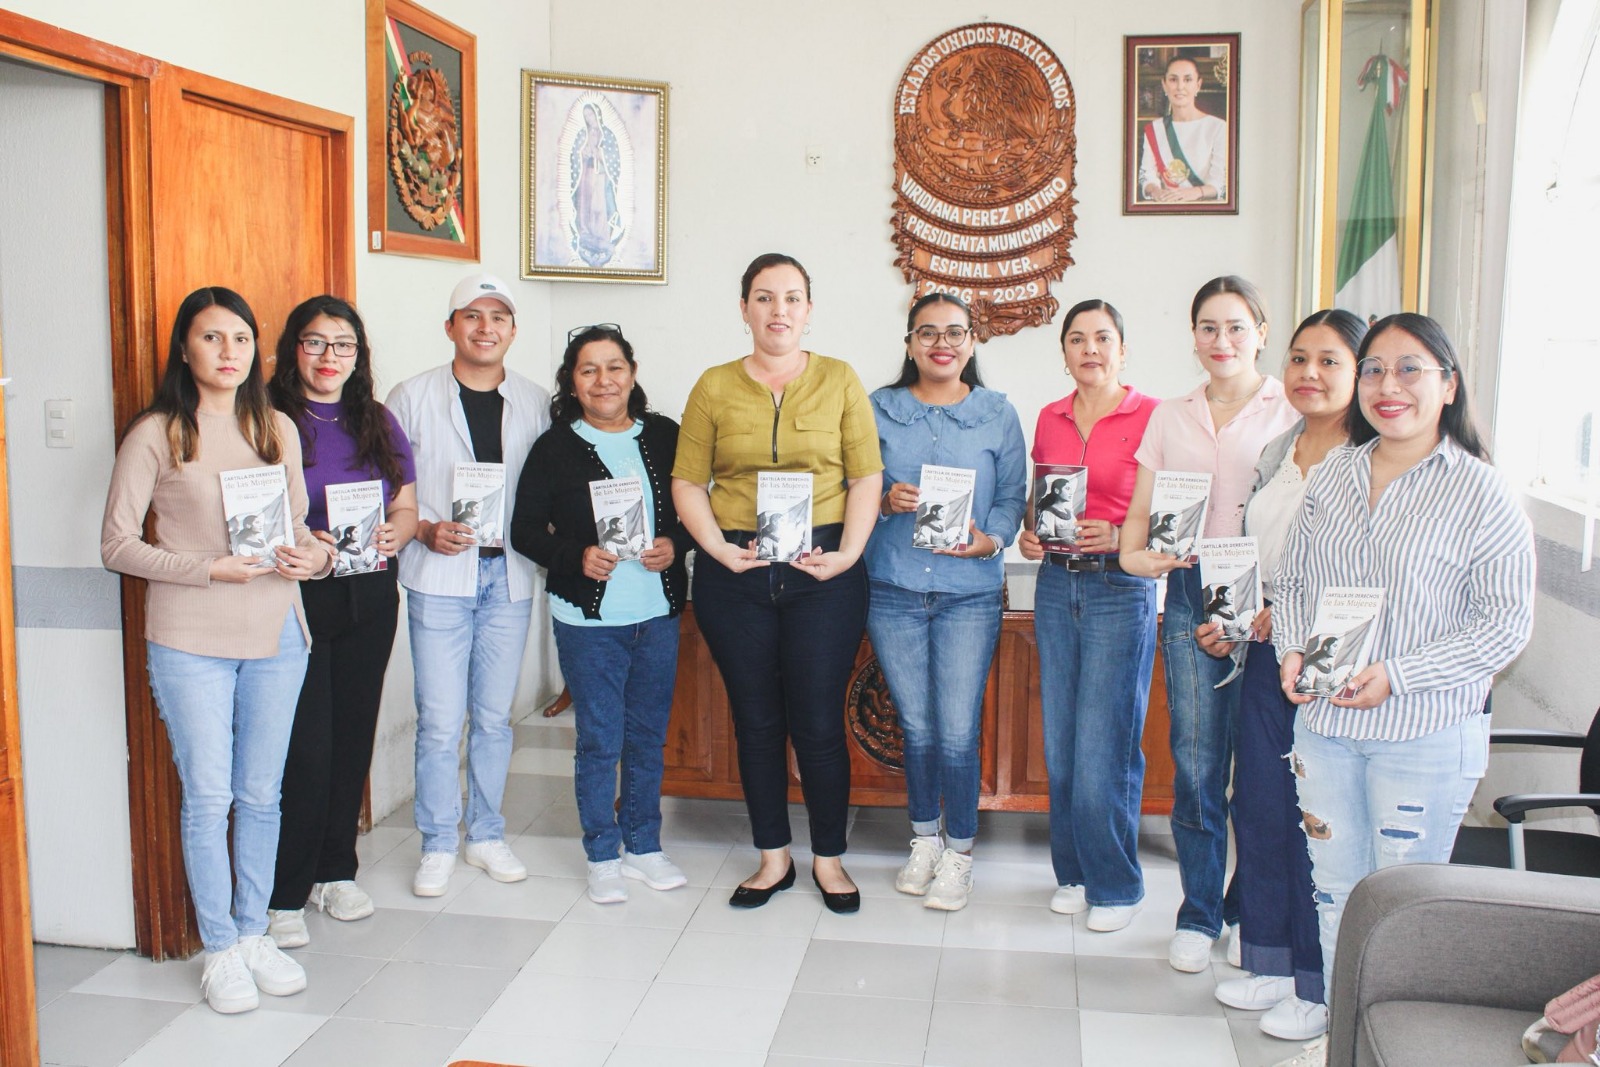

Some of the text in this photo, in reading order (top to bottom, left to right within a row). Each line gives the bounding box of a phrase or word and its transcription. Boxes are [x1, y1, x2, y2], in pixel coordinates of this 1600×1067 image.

[899, 27, 1070, 114] ESTADOS UNIDOS MEXICANOS
[900, 172, 1067, 226] VIRIDIANA PEREZ PATIÑO
[906, 215, 1061, 252] PRESIDENTA MUNICIPAL
[929, 255, 1038, 278] ESPINAL VER.
[993, 282, 1039, 303] 2029
[1225, 549, 1255, 557] Mujeres
[1323, 599, 1332, 607] de
[1346, 600, 1377, 608] Mujeres
